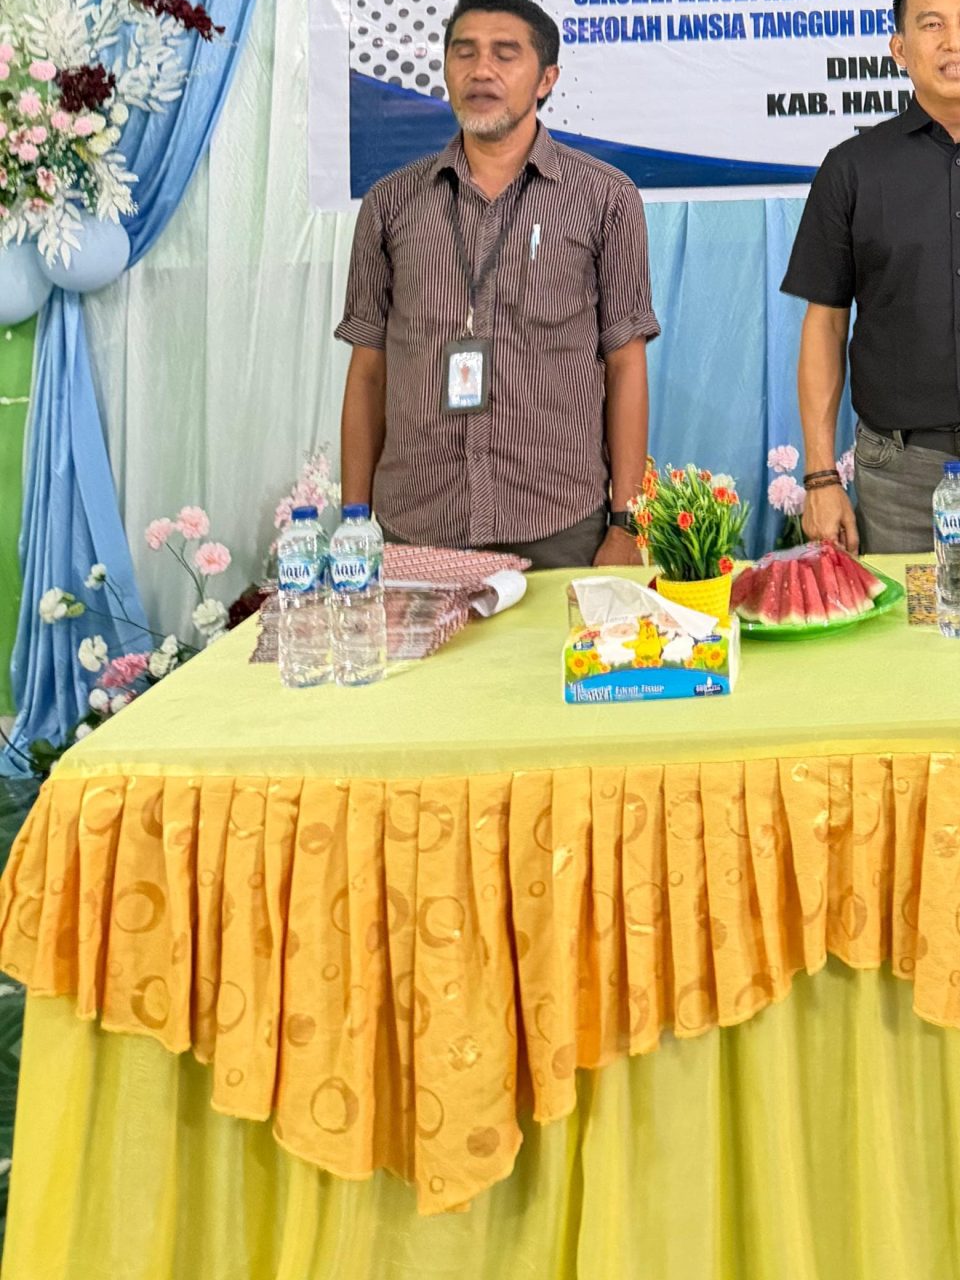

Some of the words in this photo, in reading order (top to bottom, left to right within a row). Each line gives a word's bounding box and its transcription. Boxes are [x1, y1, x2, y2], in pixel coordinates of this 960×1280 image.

[562, 15, 662, 44] SEKOLAH
[667, 13, 747, 41] LANSIA
[750, 10, 854, 38] TANGGUH
[826, 56, 911, 80] DINA
[767, 92, 836, 117] KAB.
[281, 564, 310, 579] AQUA
[334, 563, 366, 577] AQUA
